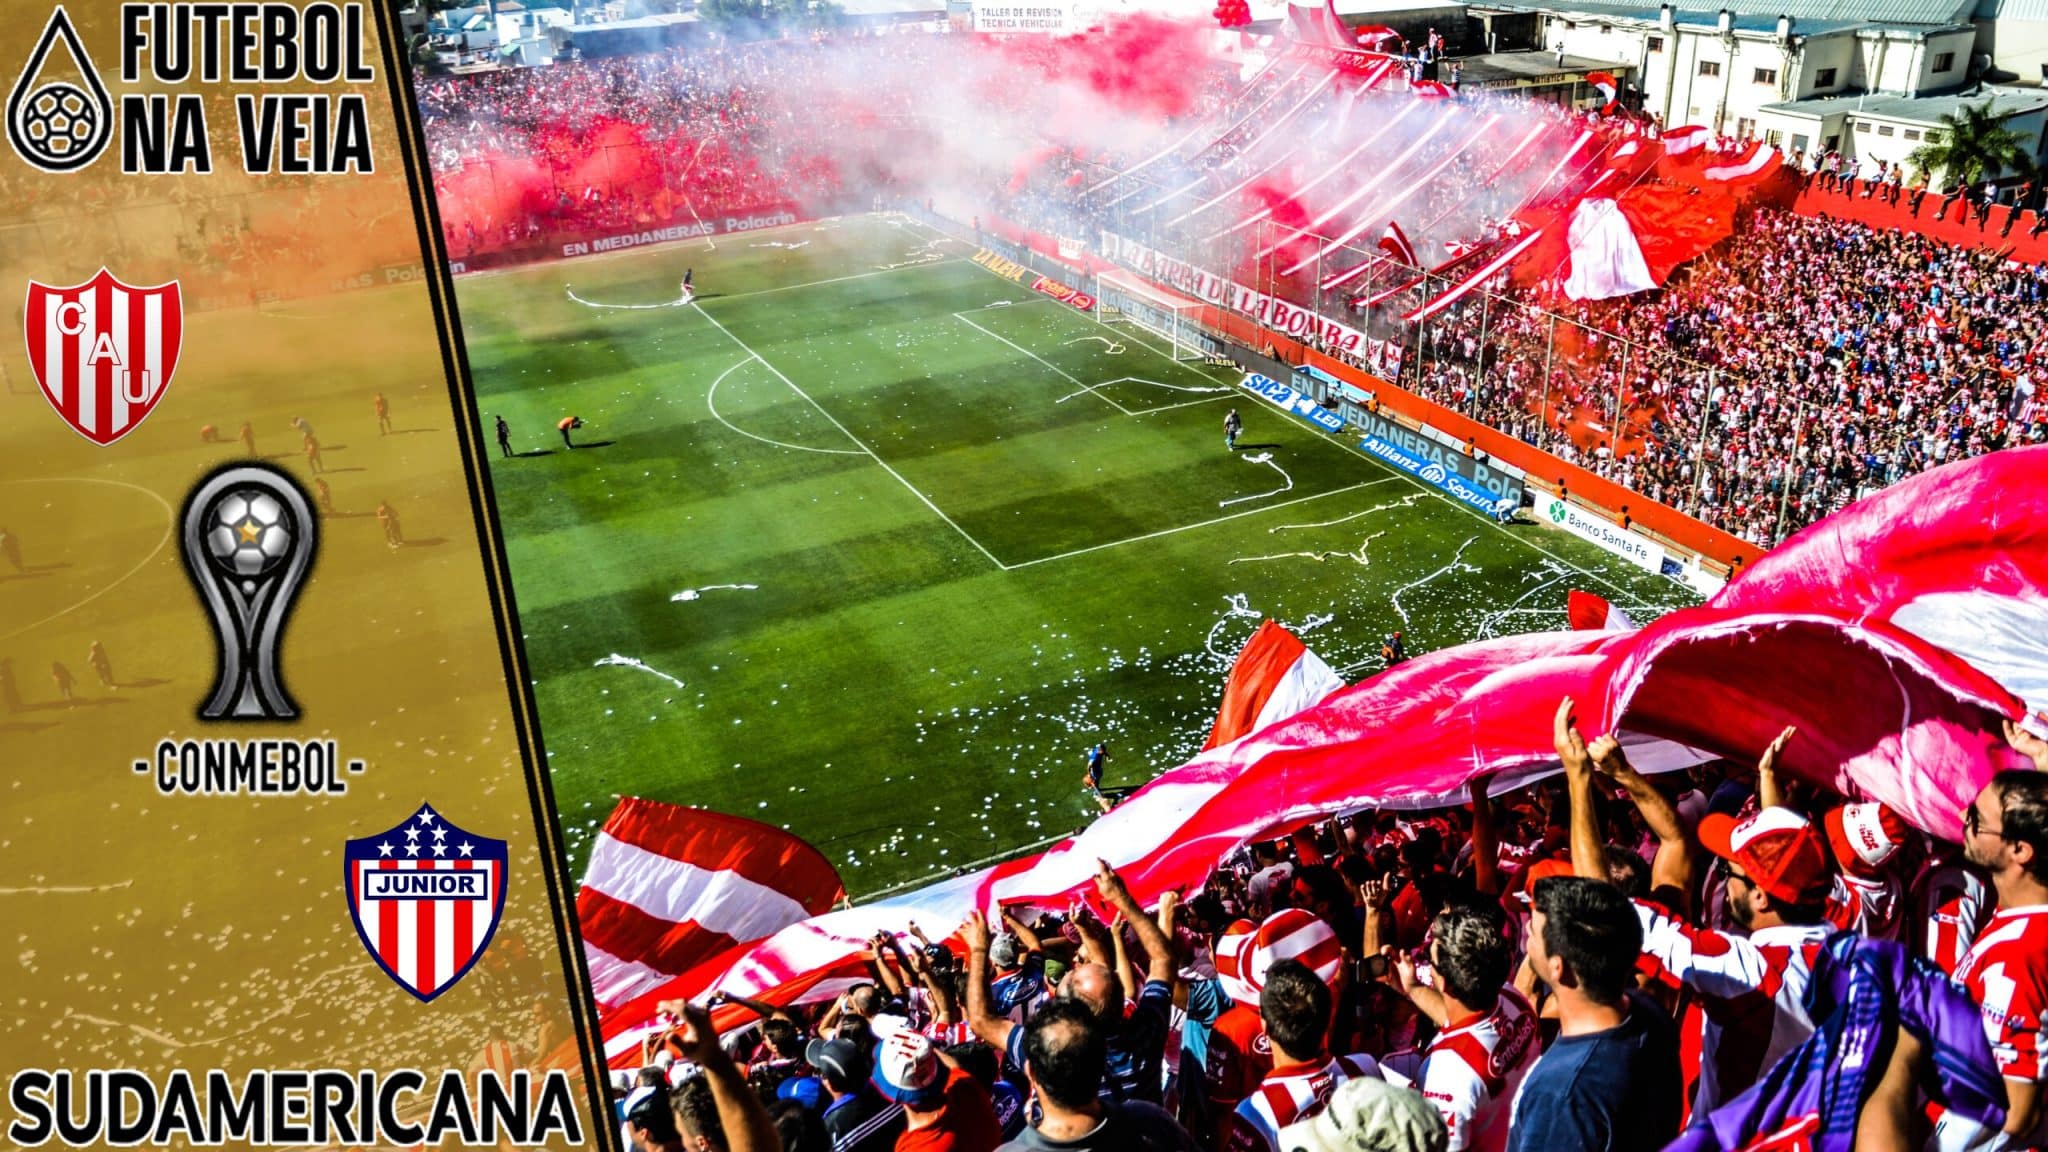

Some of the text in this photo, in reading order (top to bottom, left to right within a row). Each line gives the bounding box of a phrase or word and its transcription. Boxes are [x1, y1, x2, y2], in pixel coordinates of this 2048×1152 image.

[981, 8, 1010, 17] TALLER
[1013, 8, 1024, 17] DE
[981, 19, 1017, 28] TECNICA
[563, 212, 796, 256] EN MEDIANERAS Polacrin
[1240, 292, 1270, 322] LA
[1273, 302, 1360, 352] BOMBA
[1290, 372, 1314, 400] EN
[1312, 409, 1342, 429] LED
[1364, 438, 1501, 515] Allianz Seguro
[1568, 512, 1648, 560] Banco Santa Fe
